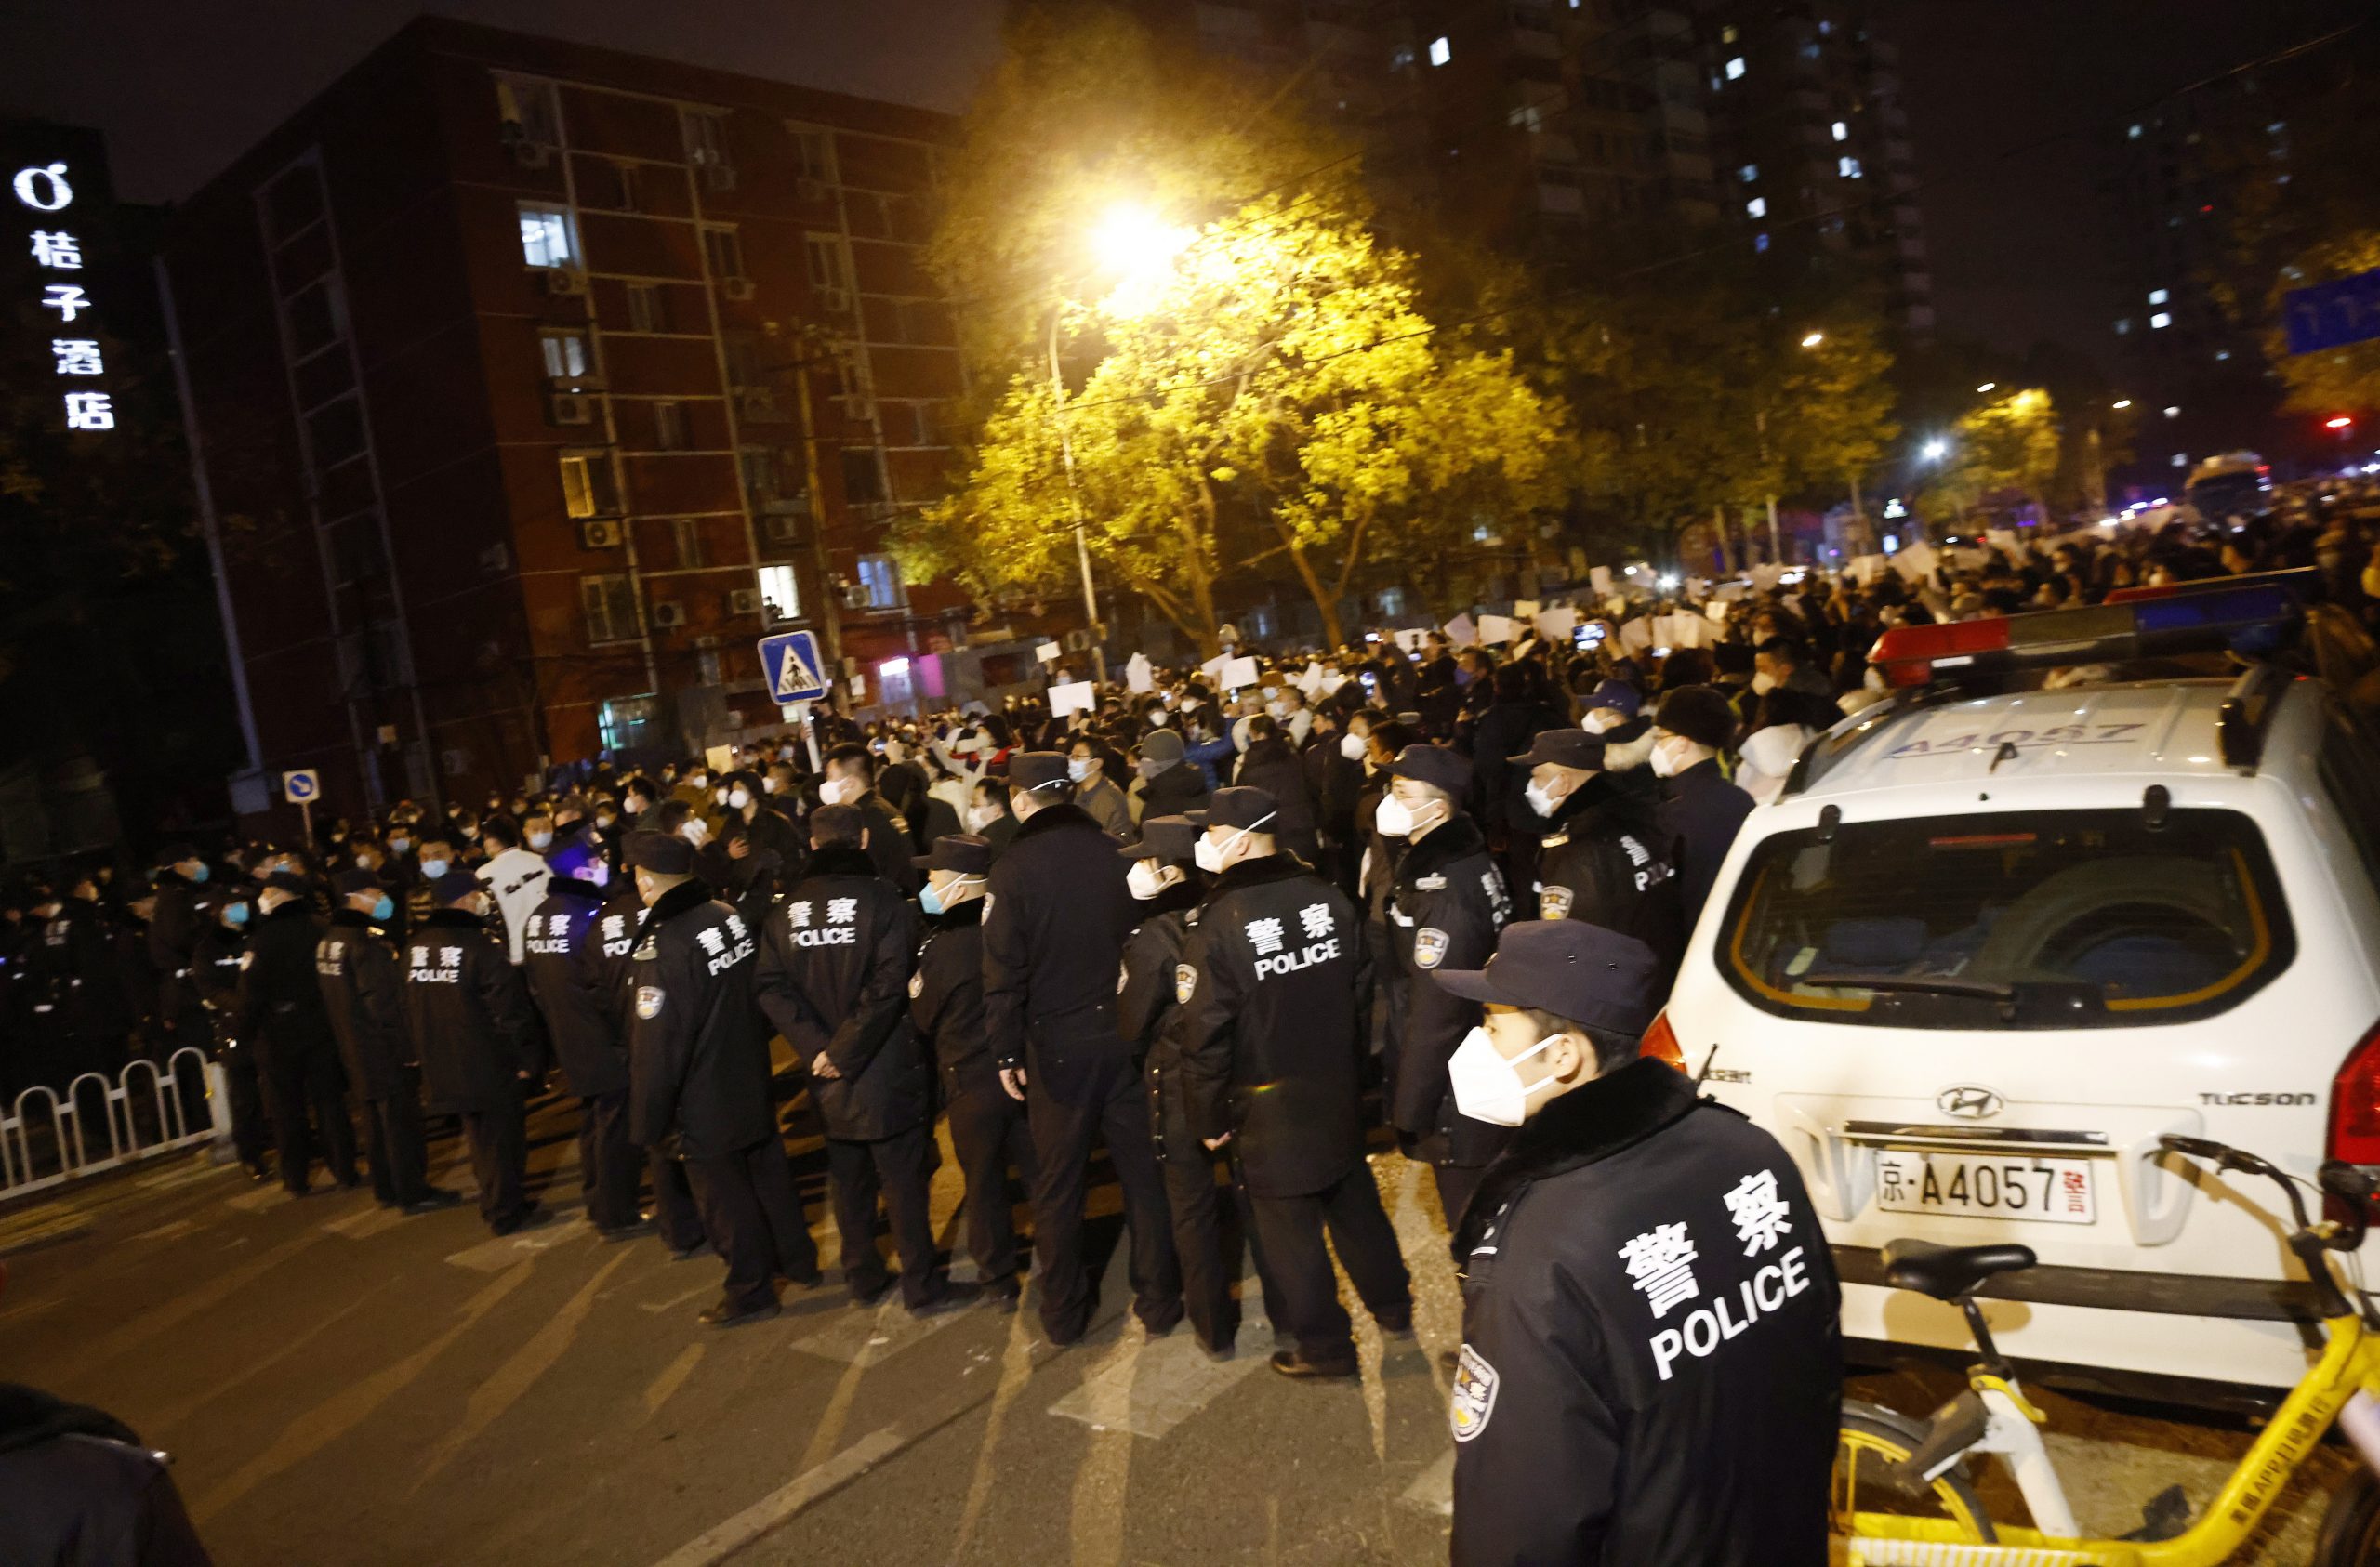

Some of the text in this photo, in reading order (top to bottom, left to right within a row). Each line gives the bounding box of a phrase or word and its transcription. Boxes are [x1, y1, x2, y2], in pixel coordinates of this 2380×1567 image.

[29, 230, 115, 430] 桔子酒店
[788, 896, 858, 928] 警察
[1244, 902, 1336, 956] 警察
[695, 914, 748, 956] 警察
[790, 928, 856, 947] POLICE
[406, 968, 461, 983] POLICE
[707, 938, 756, 977] POLICE
[1253, 937, 1342, 981] POLICE
[1617, 1168, 1792, 1320] 警察
[1648, 1245, 1811, 1382] POLICE
